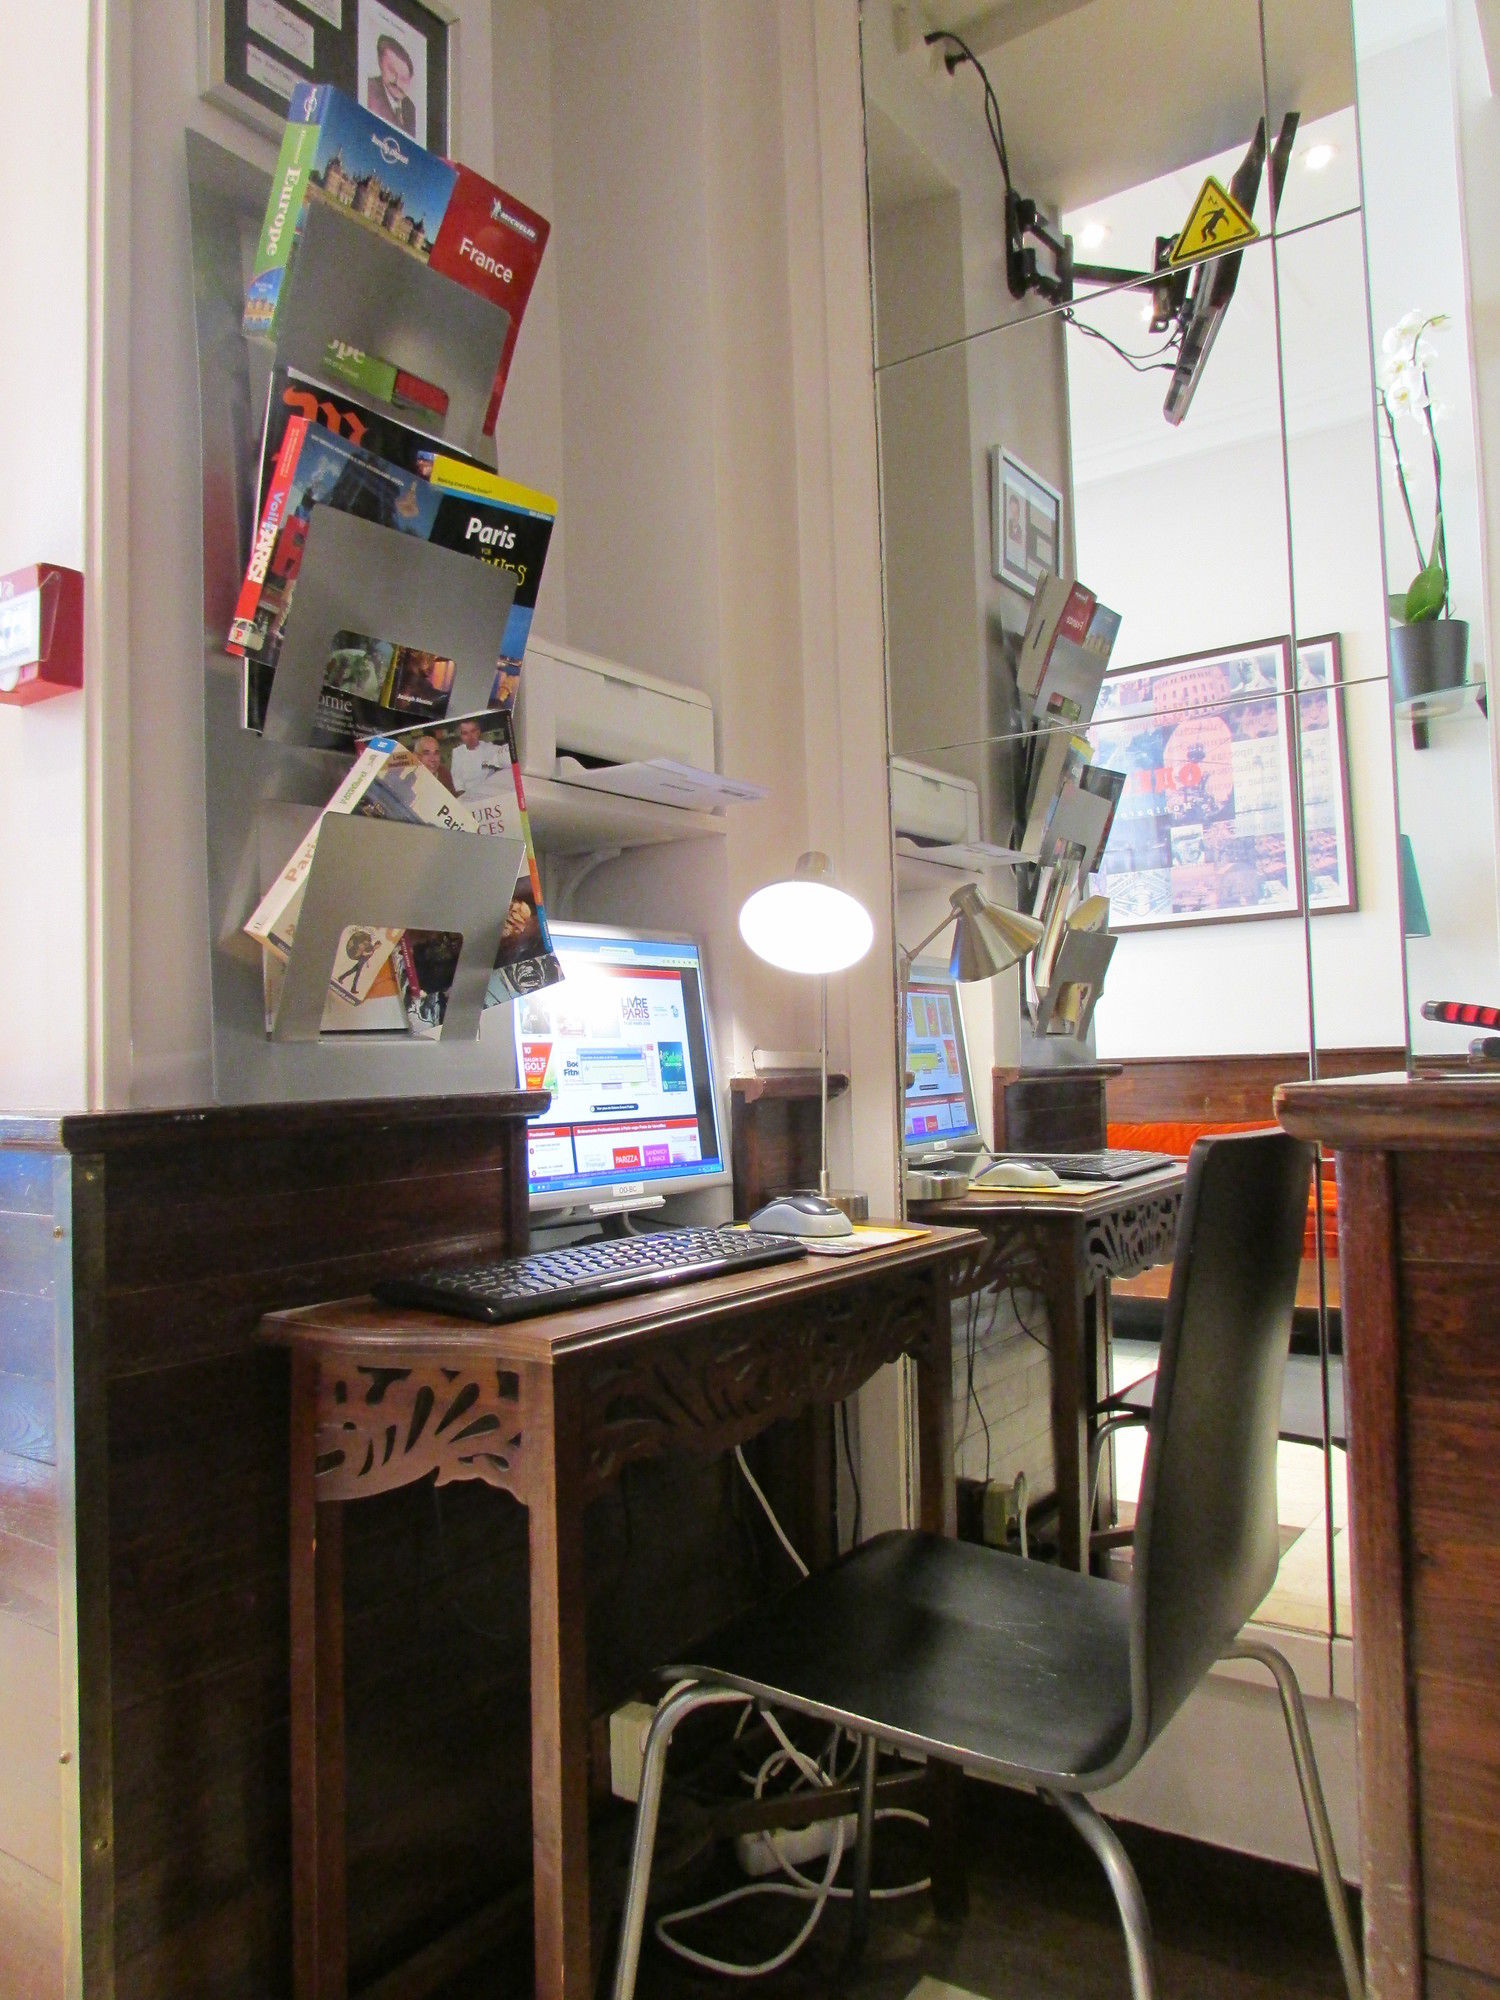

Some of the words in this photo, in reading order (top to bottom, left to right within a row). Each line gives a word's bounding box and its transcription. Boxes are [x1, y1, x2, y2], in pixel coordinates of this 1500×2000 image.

[265, 166, 301, 257] Europe
[500, 212, 536, 238] MICHELIN
[459, 237, 514, 284] France
[465, 517, 516, 549] Paris
[437, 803, 467, 833] Pari
[284, 842, 317, 882] Pari
[621, 995, 648, 1008] LIVRE
[622, 1007, 650, 1019] PARIS
[524, 1061, 546, 1070] GOLF
[615, 1154, 639, 1164] PARIZZA
